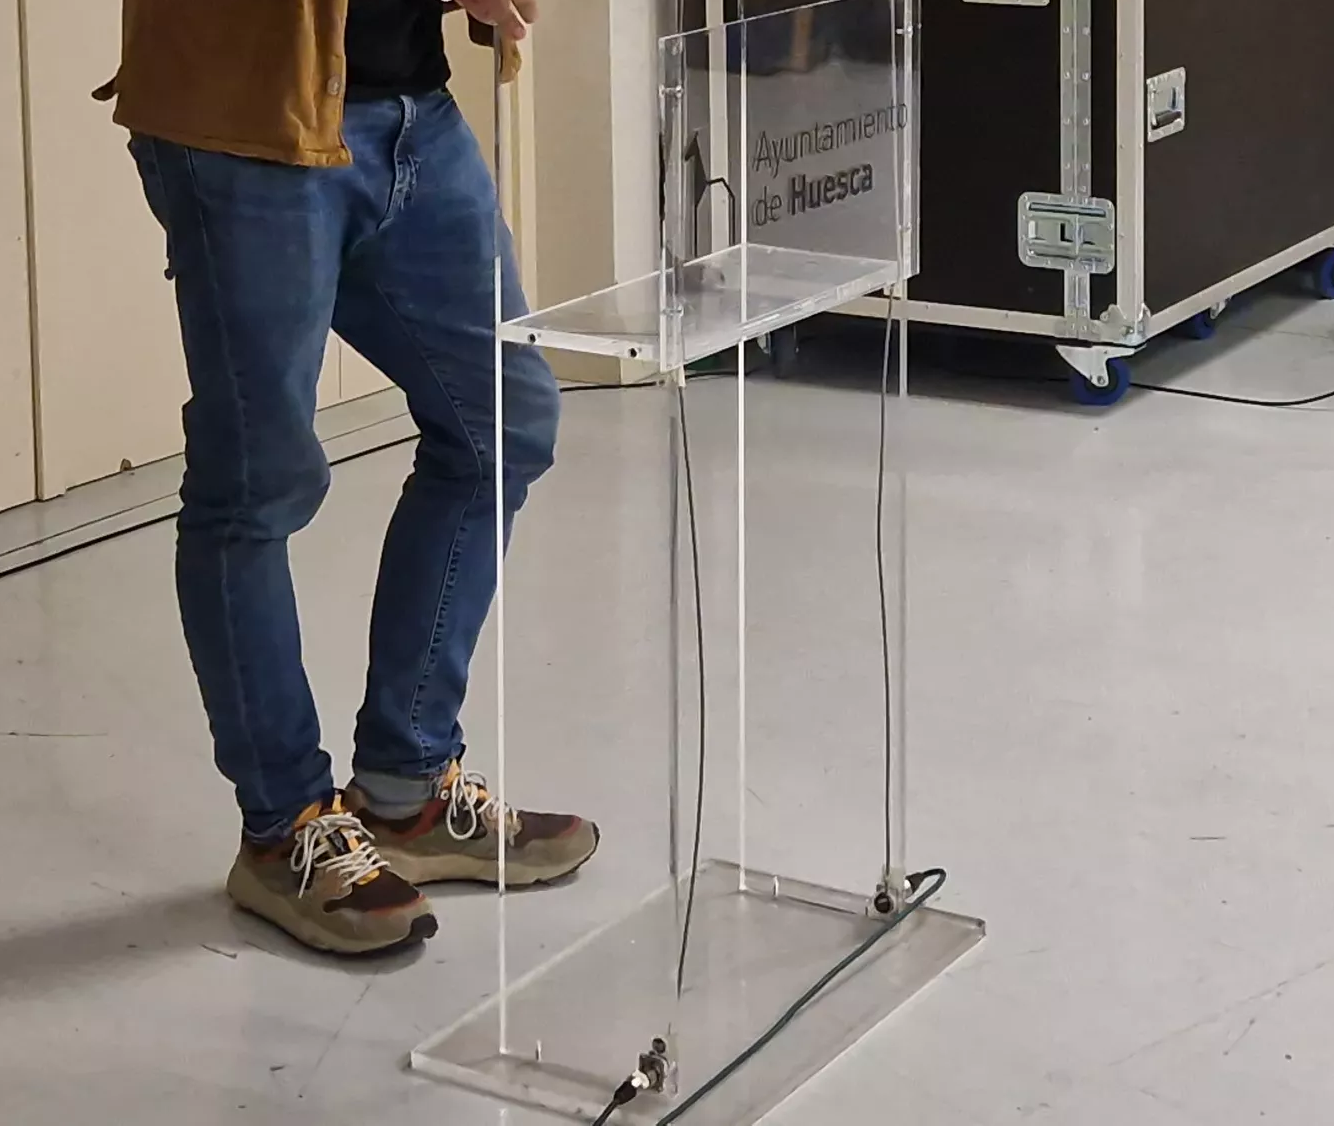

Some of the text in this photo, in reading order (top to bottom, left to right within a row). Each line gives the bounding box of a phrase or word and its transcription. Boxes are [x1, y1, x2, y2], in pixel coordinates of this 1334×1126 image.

[754, 100, 908, 178] Ayuntamiento
[753, 163, 874, 226] de Huesca
